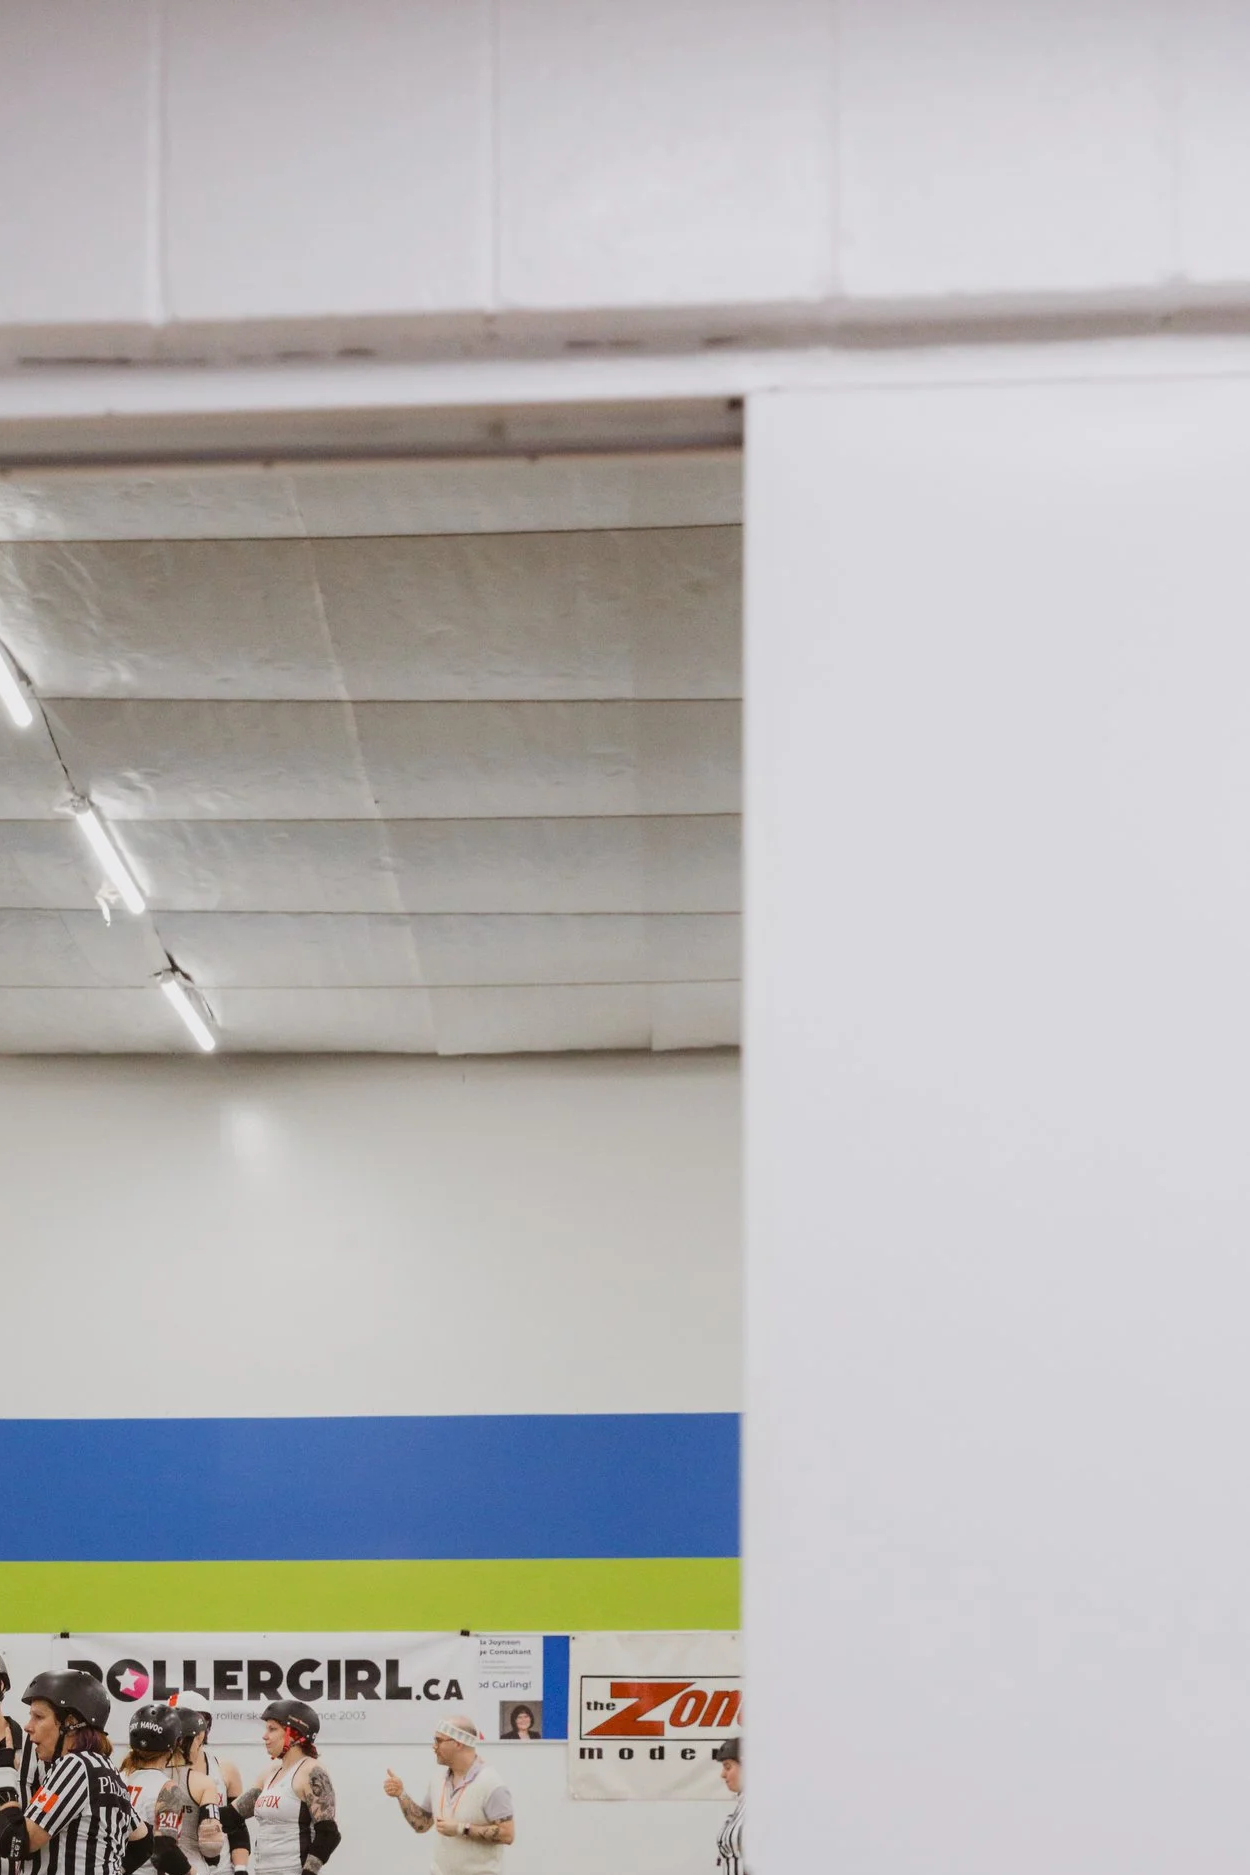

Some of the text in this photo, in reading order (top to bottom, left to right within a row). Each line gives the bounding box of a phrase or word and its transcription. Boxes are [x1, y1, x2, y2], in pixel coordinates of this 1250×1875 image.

[489, 1648, 532, 1656] Consultant
[492, 1680, 532, 1691] Curling!
[216, 1711, 244, 1720] roller
[339, 1711, 366, 1720] 2003
[584, 1682, 742, 1737] the Zon
[140, 1721, 163, 1734] HAVOC
[159, 1811, 179, 1828] 247
